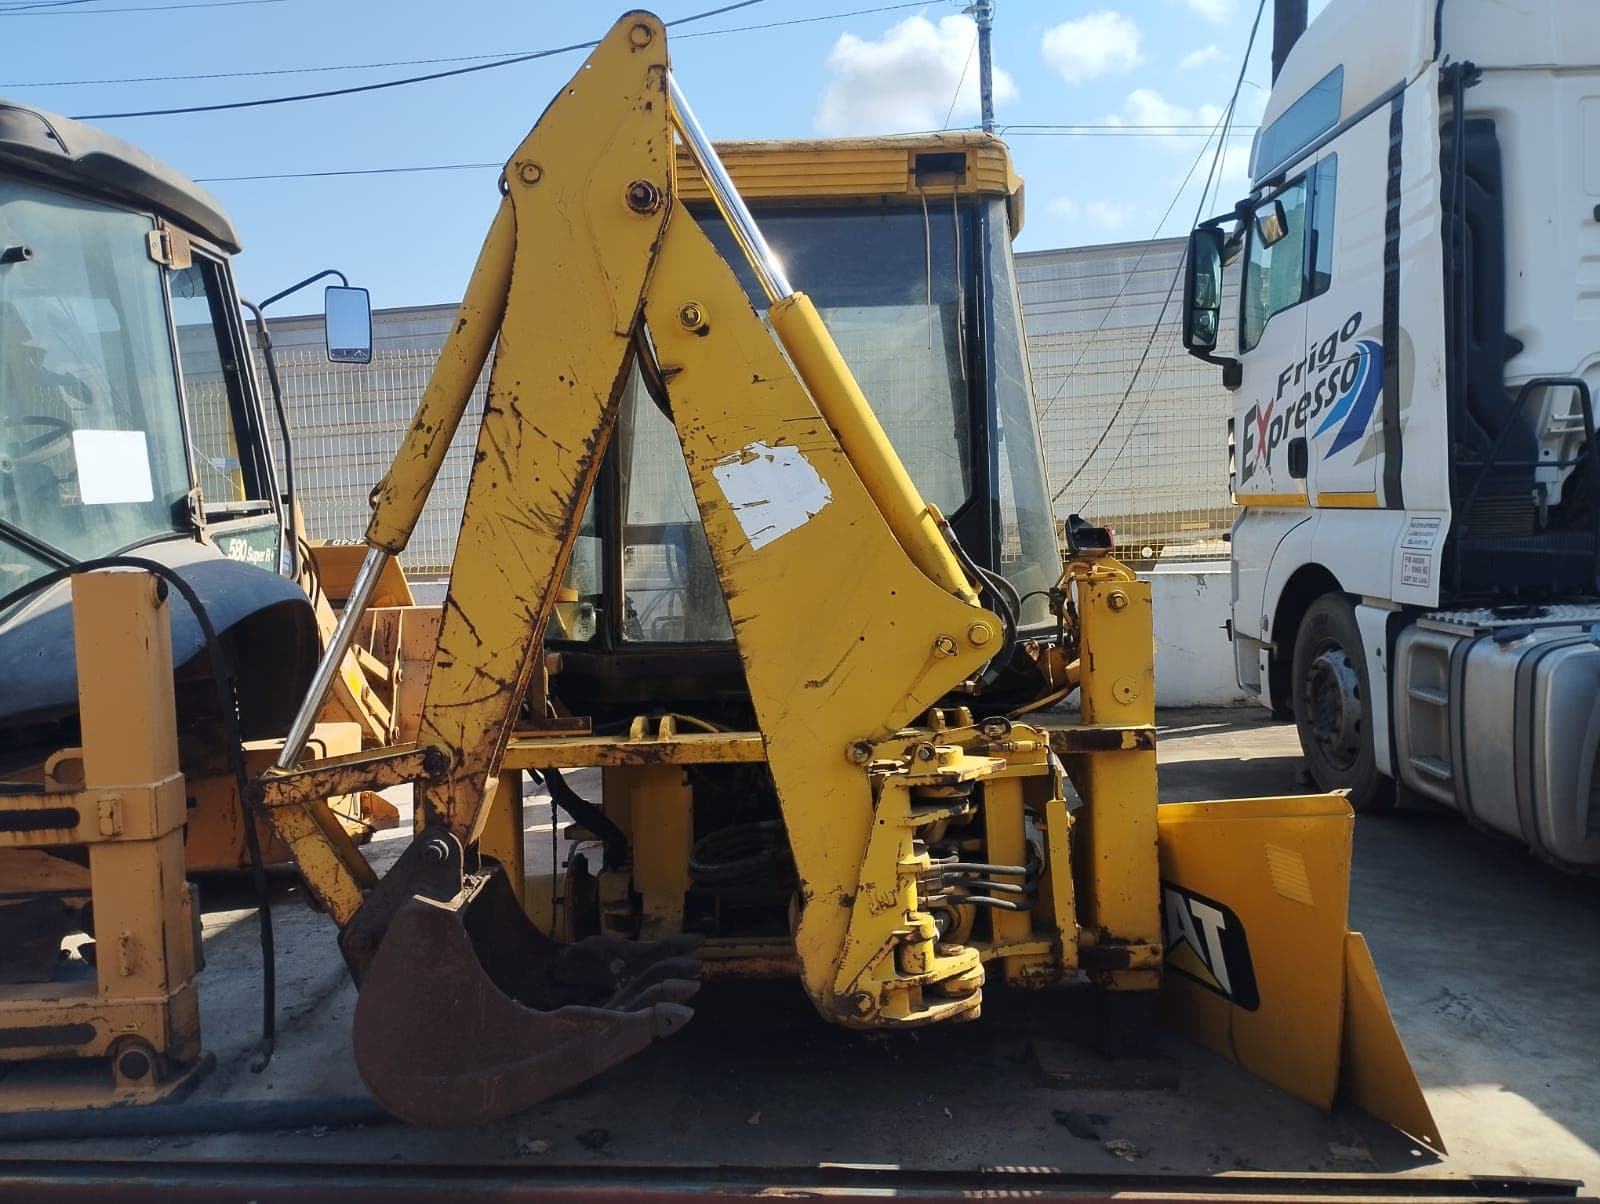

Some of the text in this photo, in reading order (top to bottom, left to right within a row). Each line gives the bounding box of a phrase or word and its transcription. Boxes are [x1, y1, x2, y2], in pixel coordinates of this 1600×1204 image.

[1277, 312, 1362, 400] Frigo
[230, 538, 248, 562] 580
[247, 546, 266, 566] Super
[1165, 888, 1232, 994] AT
